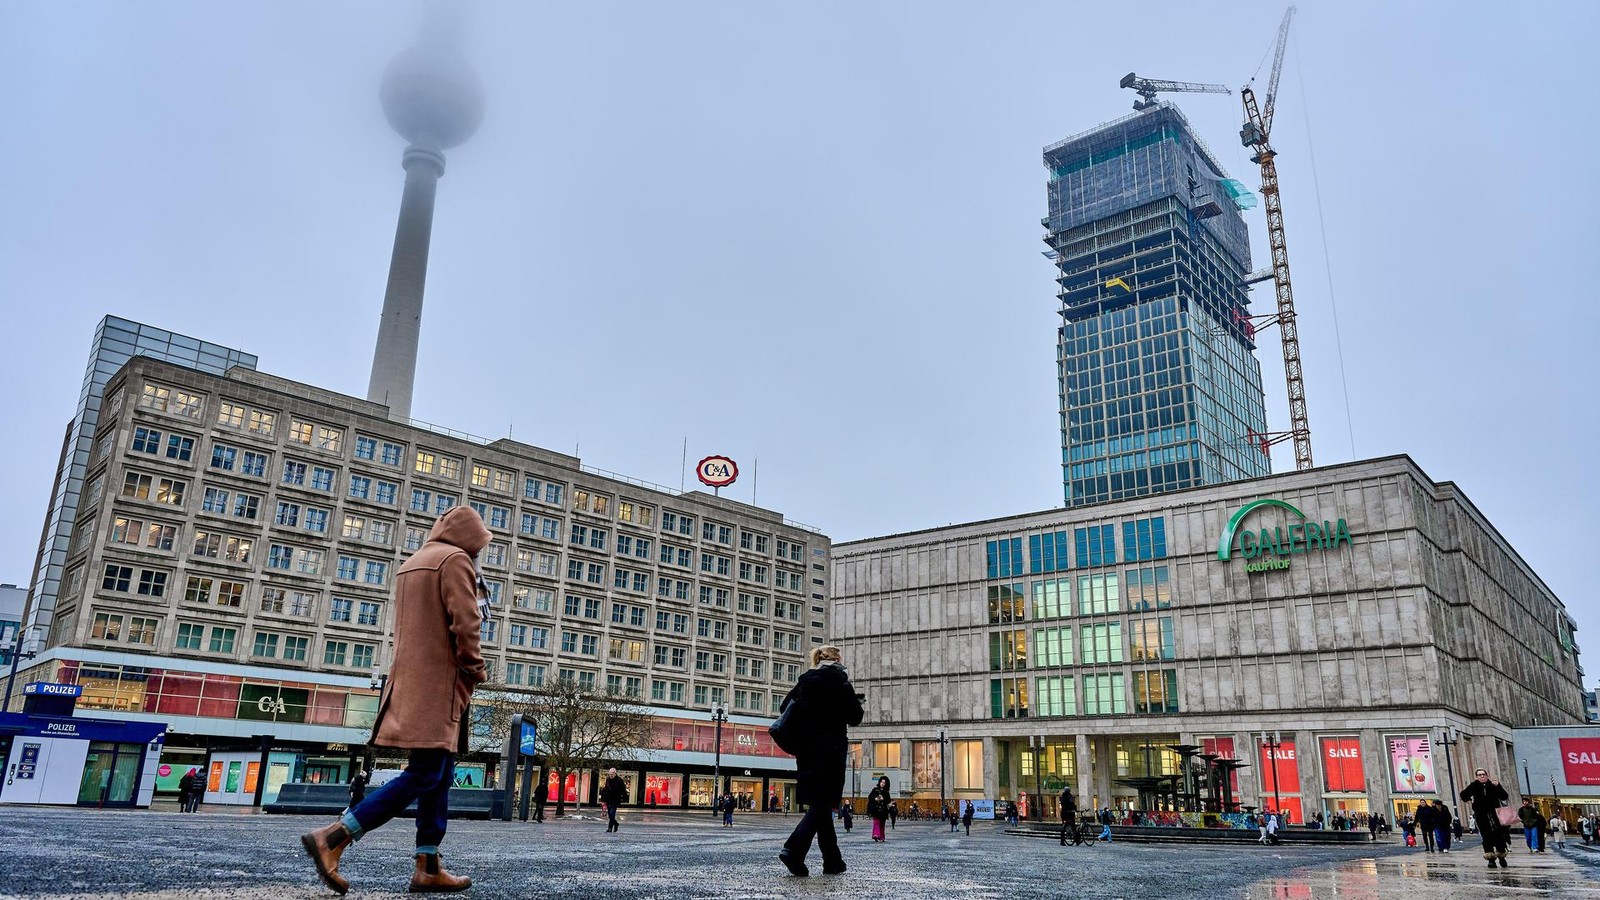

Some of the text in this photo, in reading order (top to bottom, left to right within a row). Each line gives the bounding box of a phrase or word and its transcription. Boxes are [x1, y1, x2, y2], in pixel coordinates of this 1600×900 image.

[704, 463, 730, 477] C&A
[1240, 518, 1354, 559] GALERIA
[1244, 559, 1291, 573] KAUFHOF
[43, 685, 76, 695] POLIZEI
[258, 696, 286, 714] C&A
[47, 723, 76, 732] POLIZEI
[331, 743, 345, 751] dm
[1266, 749, 1295, 760] SALE
[1329, 748, 1358, 758] SALE
